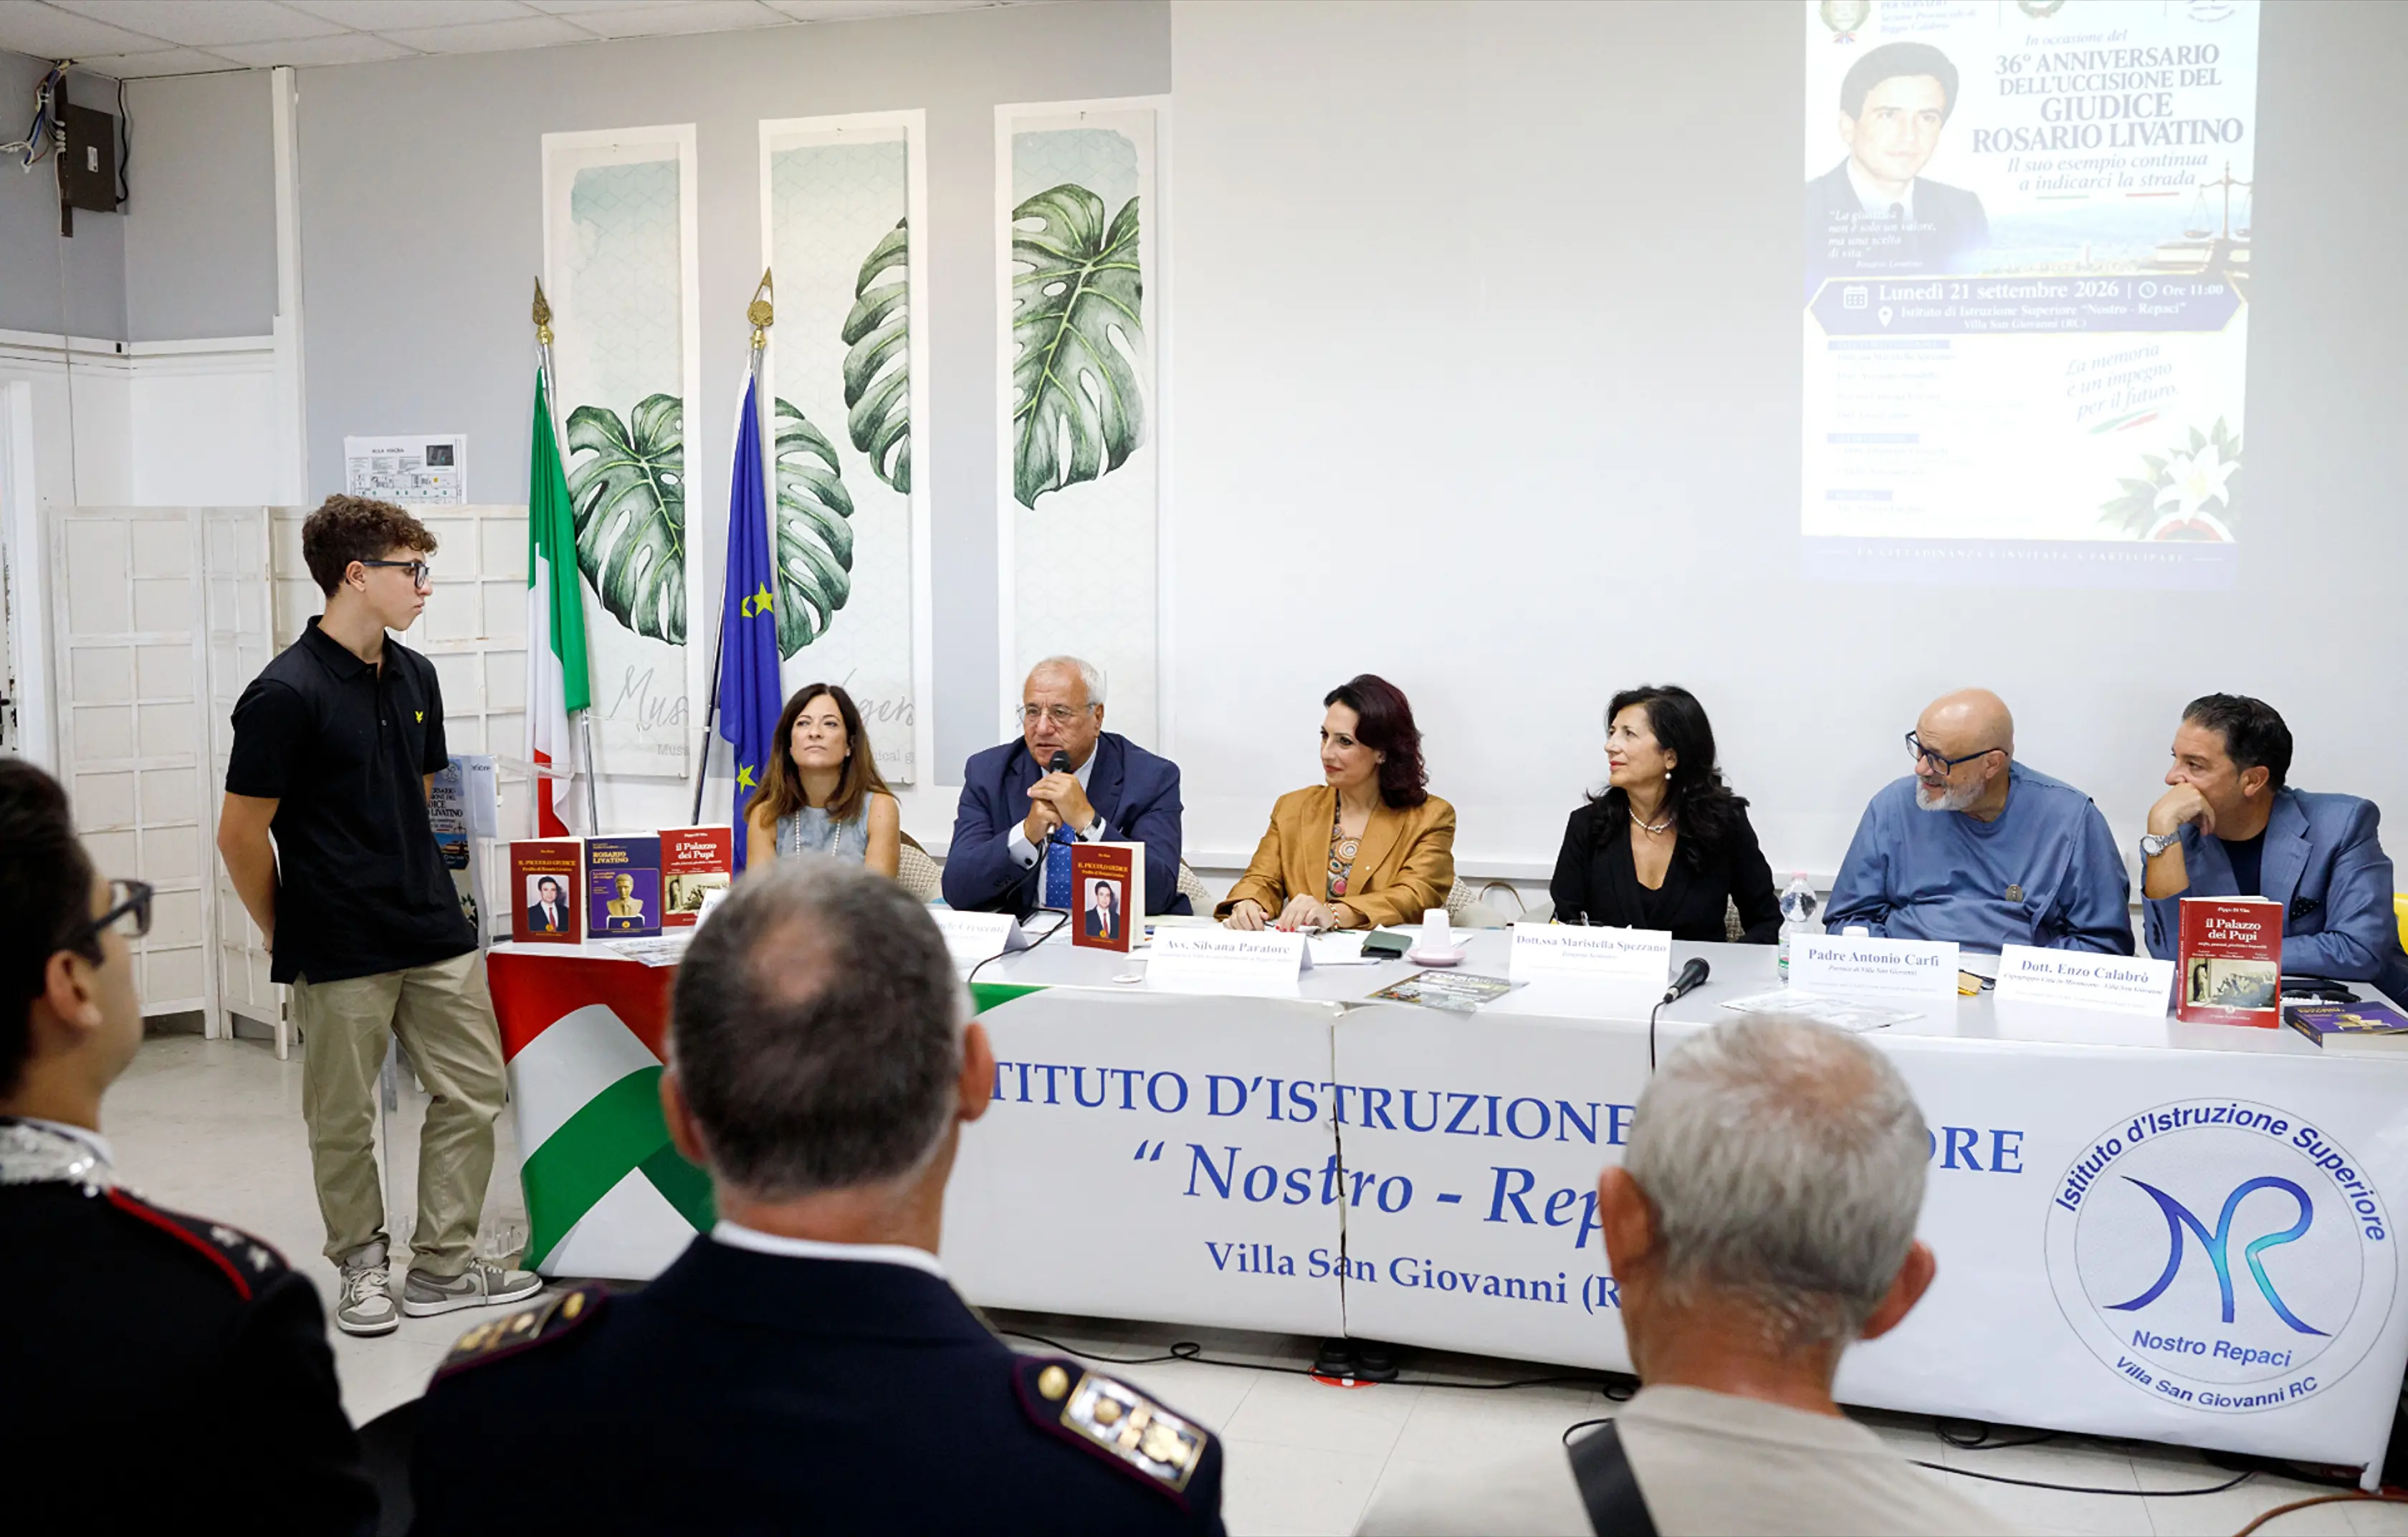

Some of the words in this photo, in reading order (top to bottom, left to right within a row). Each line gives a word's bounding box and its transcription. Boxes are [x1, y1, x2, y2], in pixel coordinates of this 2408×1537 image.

[2025, 34, 2038, 47] In
[2042, 32, 2103, 46] occasione
[2107, 29, 2128, 42] del
[2035, 44, 2220, 73] ANNIVERSARIO
[2179, 67, 2222, 87] DEL
[2040, 92, 2174, 122] GIUDICE
[1972, 123, 2103, 153] ROSARIO
[2108, 118, 2244, 148] LIVATINO
[2007, 157, 2021, 173] Il
[2025, 159, 2053, 172] suo
[2057, 153, 2126, 173] esempio
[2131, 152, 2209, 169] continua
[2018, 179, 2029, 191] a
[2035, 172, 2113, 191] indicarci
[2117, 173, 2134, 189] la
[2139, 169, 2197, 188] strada
[1878, 283, 1944, 301] Lunedì
[1949, 285, 1969, 300] 21
[1976, 284, 2068, 300] settembre
[2073, 282, 2119, 298] 2026
[2161, 285, 2186, 297] Ore
[2189, 283, 2225, 295] 11:00
[1901, 305, 1941, 318] Istituto
[1944, 305, 1956, 317] di
[1959, 305, 2018, 317] Istruzione
[2021, 303, 2078, 318] Superiore
[1964, 320, 1988, 330] Villa
[1990, 320, 2009, 330] San
[2011, 319, 2058, 330] Giovanni
[2065, 358, 2087, 376] La
[2091, 342, 2160, 371] memoria
[2080, 378, 2102, 394] un
[2106, 362, 2173, 389] impegno
[2075, 399, 2107, 422] per
[2110, 390, 2121, 410] il
[684, 842, 717, 850] Palazzo
[693, 850, 715, 860] Pupi
[2205, 918, 2214, 928] il
[2216, 918, 2261, 931] Palazzo
[1165, 940, 1189, 950] Avv.
[1192, 941, 1236, 952] Silvana
[1238, 942, 1291, 954] Paratore
[1561, 937, 1614, 950] Maristella
[1617, 941, 1667, 953] Spezzano
[2208, 930, 2227, 939] dei
[2229, 931, 2257, 943] Pupi
[1807, 948, 1846, 961] Padre
[1848, 951, 1901, 964] Antonio
[2021, 959, 2053, 974] Dott.
[2057, 963, 2090, 977] Enzo
[2093, 966, 2149, 984] Calabrò
[1184, 1143, 1413, 1214] Nostro
[2055, 1138, 2123, 1213] Istituto
[2126, 1102, 2290, 1145] d'Istruzione
[2291, 1126, 2386, 1242] Superiore
[1205, 1241, 1295, 1276] Villa
[1308, 1249, 1377, 1283] San
[1388, 1257, 1568, 1305] Giovanni
[2132, 1329, 2207, 1357] Nostro
[2212, 1341, 2293, 1368] Repaci
[2115, 1356, 2153, 1386] Villa
[2154, 1379, 2194, 1402] San
[2197, 1387, 2285, 1408] Giovanni
[2288, 1376, 2318, 1399] RC
